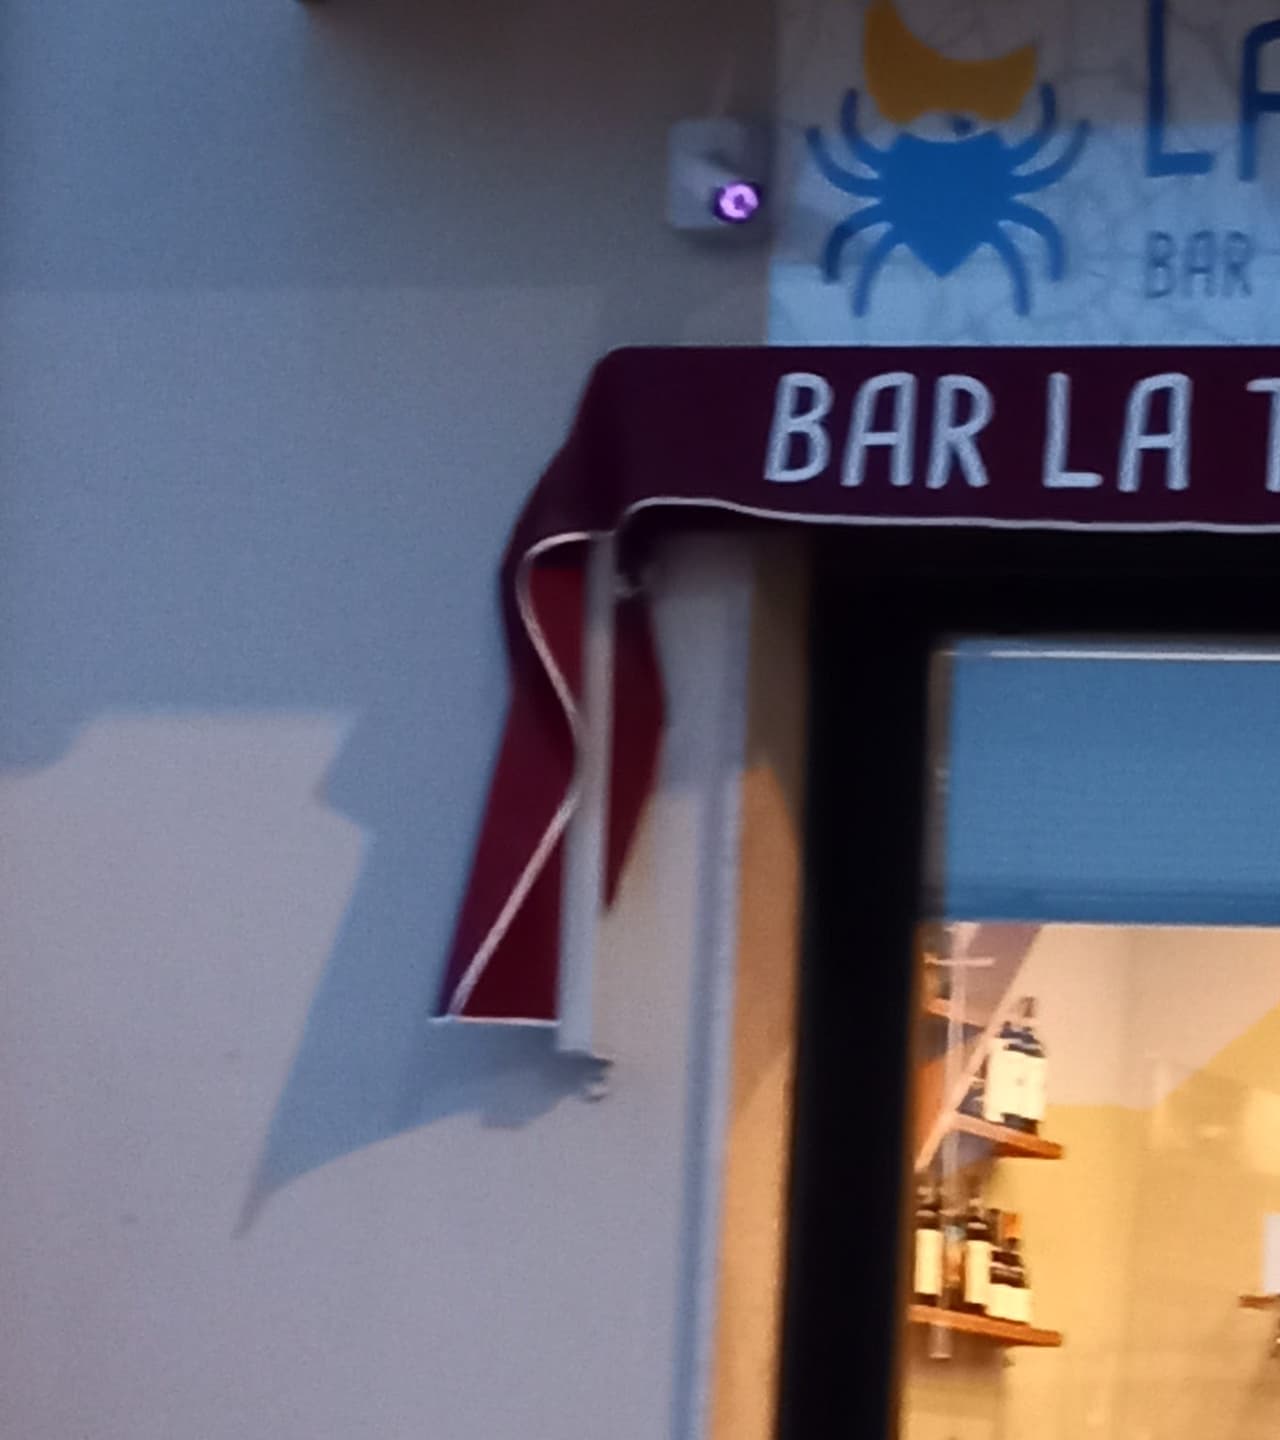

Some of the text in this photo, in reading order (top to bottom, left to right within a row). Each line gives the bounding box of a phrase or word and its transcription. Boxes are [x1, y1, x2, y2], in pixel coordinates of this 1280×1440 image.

[1144, 228, 1252, 299] BAR
[764, 370, 995, 490] BAR
[1042, 371, 1194, 494] LA
